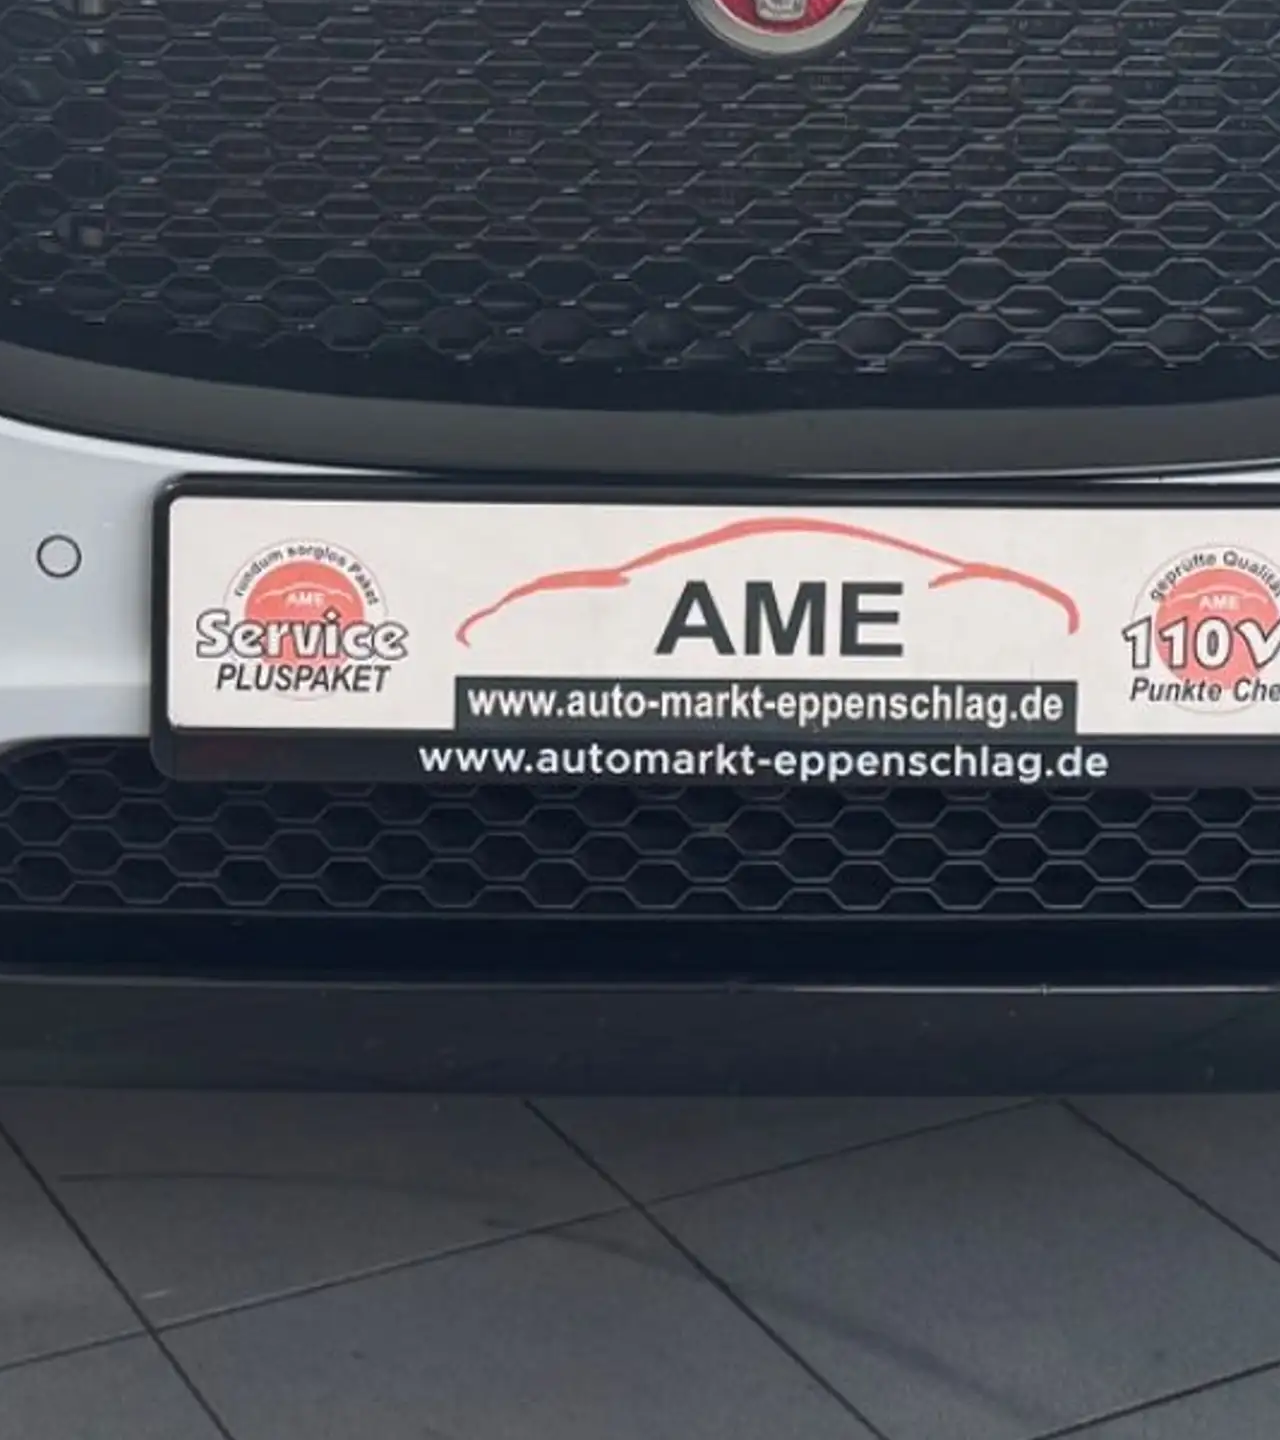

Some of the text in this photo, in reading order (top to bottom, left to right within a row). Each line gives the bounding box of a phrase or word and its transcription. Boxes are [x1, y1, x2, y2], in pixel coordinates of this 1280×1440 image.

[196, 607, 409, 661] Service
[656, 580, 904, 657] AME
[215, 663, 392, 693] PLUSPAKET
[1129, 676, 1222, 703] Punkte
[467, 683, 1064, 728] www.auto-markt-eppenschlag.de
[419, 743, 1110, 783] www.automarkt-eppenschlag.de
